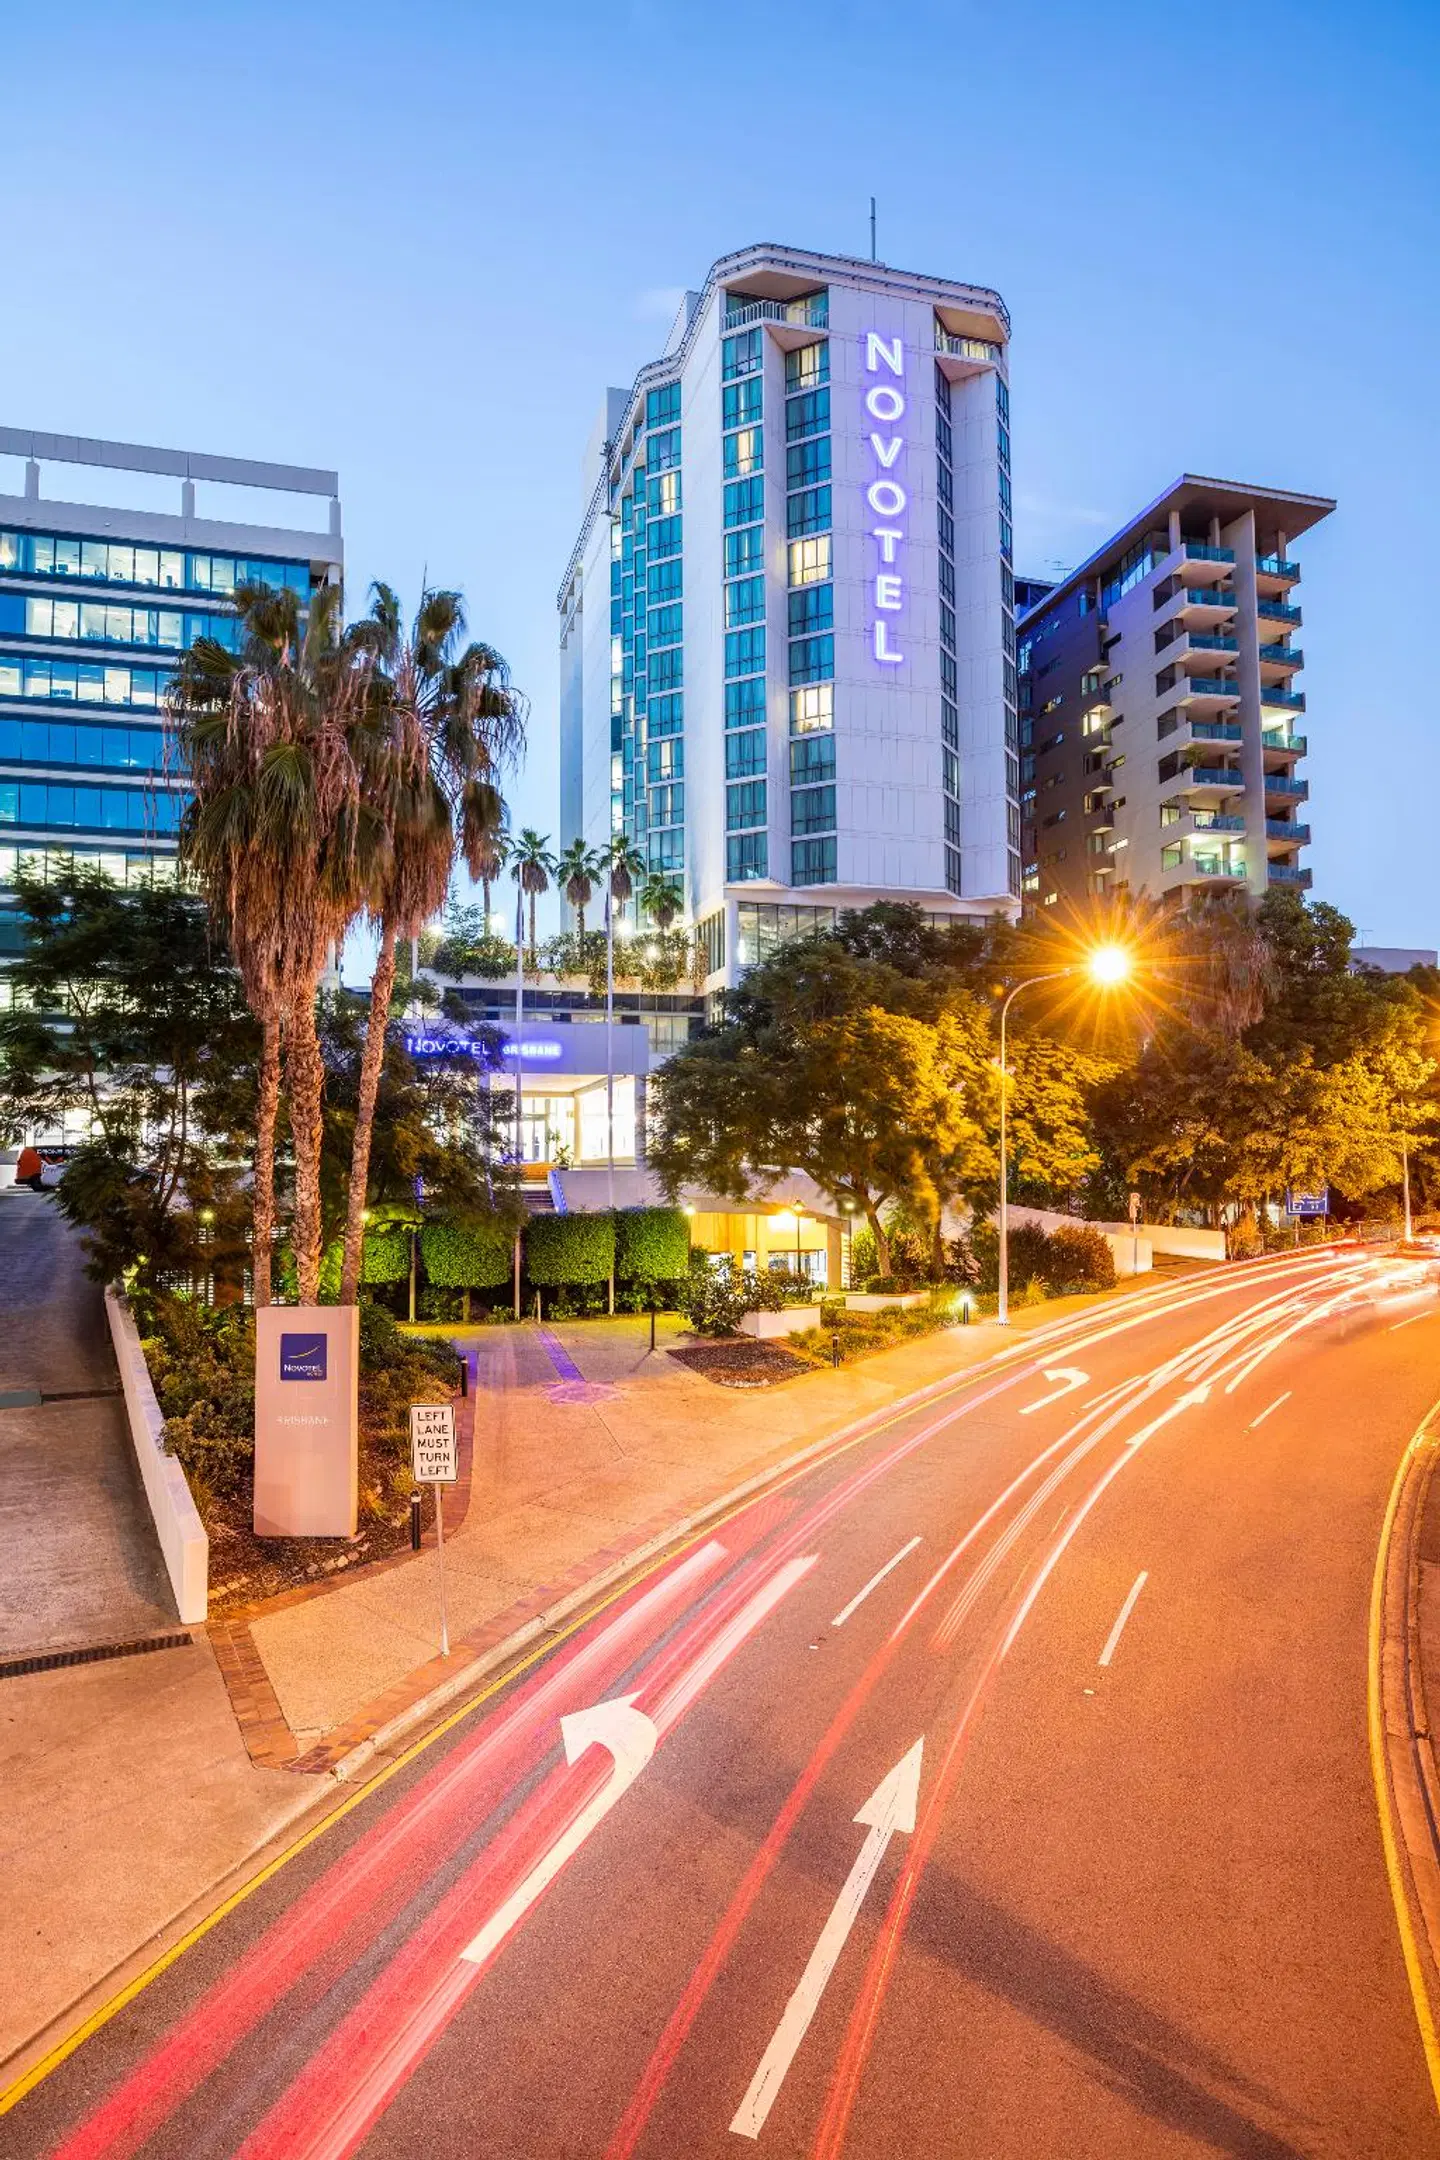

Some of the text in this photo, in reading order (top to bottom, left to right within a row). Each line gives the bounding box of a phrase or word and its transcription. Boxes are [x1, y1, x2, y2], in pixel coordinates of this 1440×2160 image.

[866, 332, 906, 662] NOVOTEL
[407, 1037, 561, 1057] NOVOTEL BRSBANE
[284, 1364, 323, 1373] NOVOTEL
[417, 1411, 446, 1422] LEFT
[417, 1424, 449, 1435] LANE
[417, 1438, 450, 1449] MUST
[419, 1452, 450, 1462] TURN
[420, 1465, 450, 1477] LEFT
